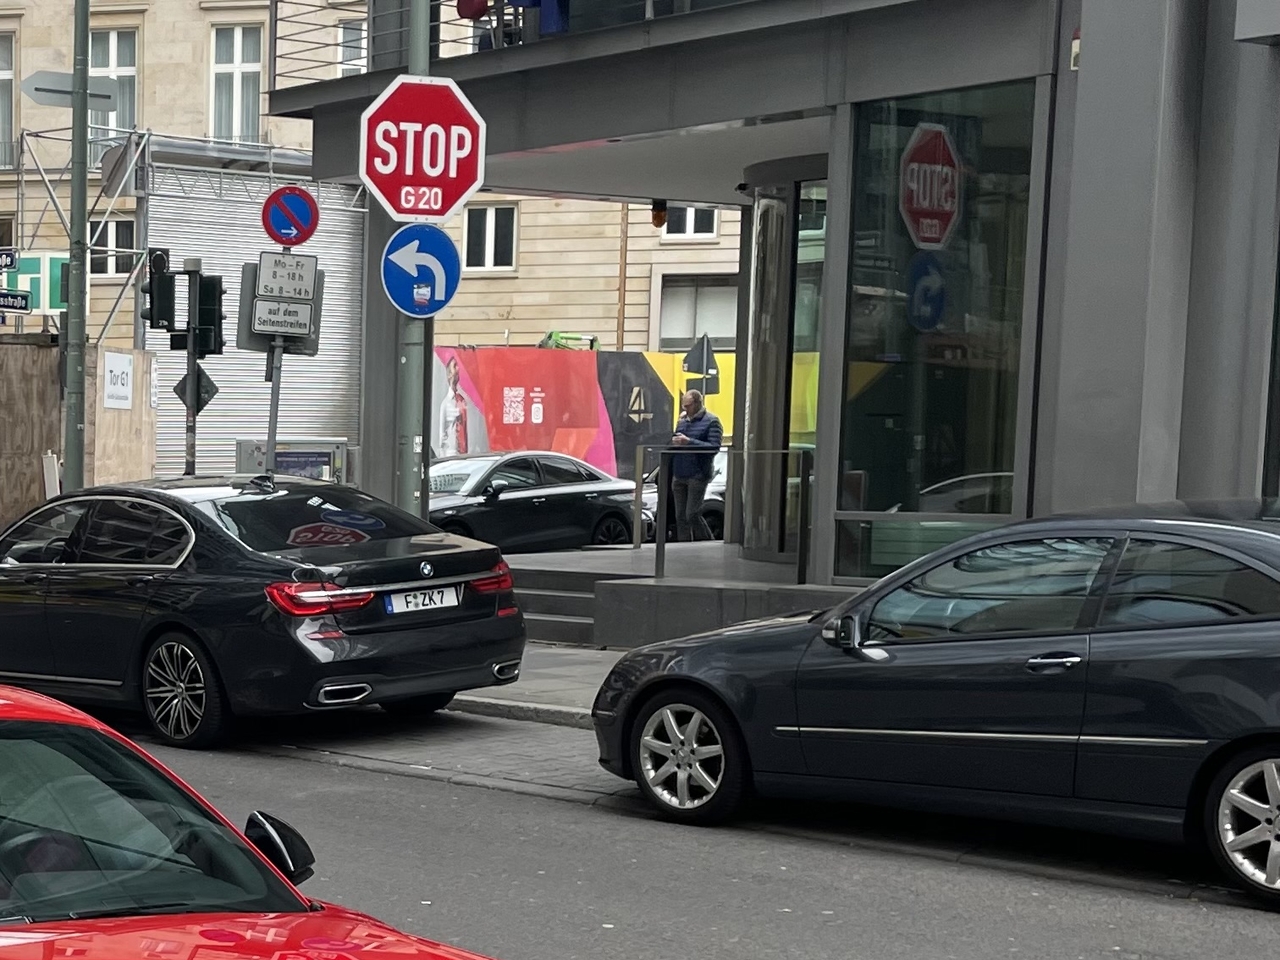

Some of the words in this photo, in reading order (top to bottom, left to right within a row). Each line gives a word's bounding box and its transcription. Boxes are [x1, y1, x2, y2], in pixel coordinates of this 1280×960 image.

[373, 121, 473, 178] STOP
[273, 259, 286, 269] Mo
[295, 261, 305, 270] Fr
[272, 270, 278, 279] 8
[287, 272, 296, 281] 18
[298, 273, 304, 281] h
[263, 284, 274, 294] Sa
[278, 286, 284, 295] 8
[293, 287, 302, 296] 14
[304, 288, 310, 297] h
[267, 307, 280, 316] auf
[282, 308, 299, 317] dem
[257, 316, 307, 330] Seitenstreifen
[109, 369, 120, 386] Tor
[404, 594, 413, 609] F
[420, 591, 437, 607] ZK
[437, 590, 445, 605] 7
